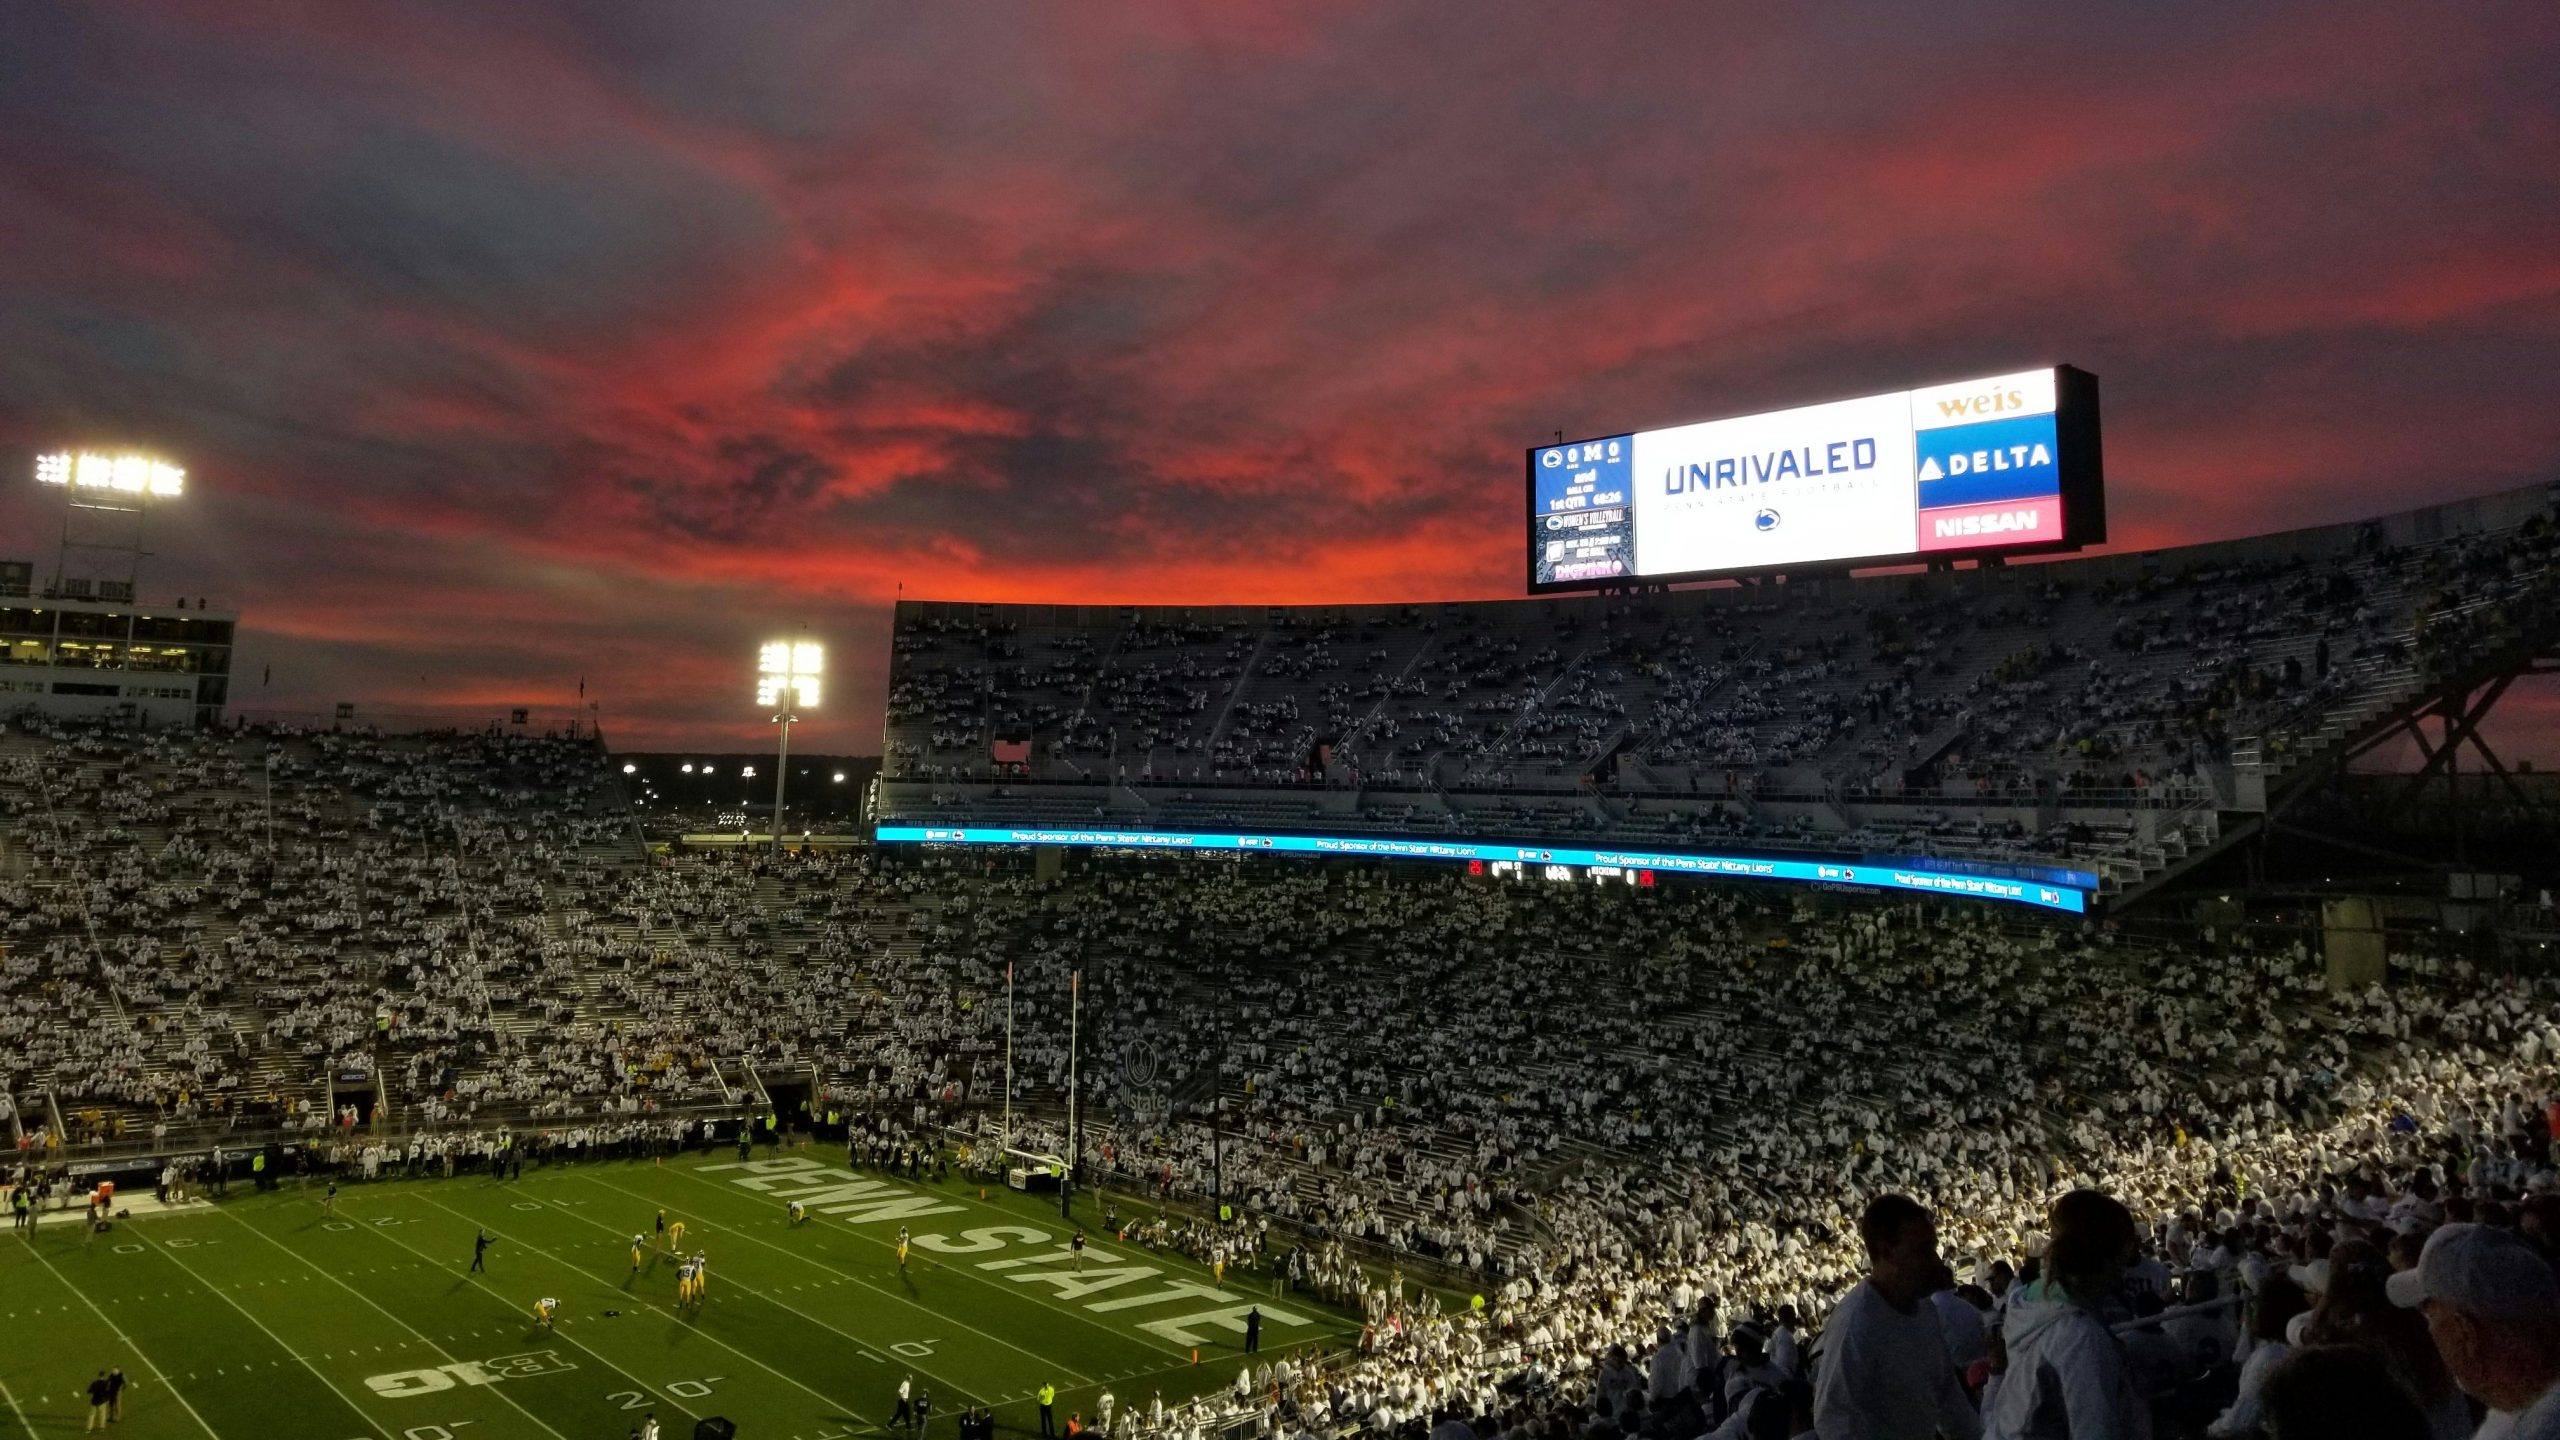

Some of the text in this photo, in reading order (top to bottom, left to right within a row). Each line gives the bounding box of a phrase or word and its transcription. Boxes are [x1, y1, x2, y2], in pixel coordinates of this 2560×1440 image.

[1937, 385, 2023, 418] weis
[1567, 442, 1619, 463] 0 M 0
[1950, 443, 2050, 476] DELTA
[1665, 437, 1876, 496] UNRIVALED
[1565, 496, 1586, 510] QTR
[1935, 510, 2037, 538] NISSAN
[1011, 831, 1035, 840] Proud
[1037, 832, 1068, 842] Sponsor
[1070, 833, 1080, 841] of
[1081, 833, 1094, 841] the
[1096, 833, 1115, 842] Penn
[1141, 834, 1169, 845] Nittany
[1316, 840, 1338, 849] Proud
[1340, 841, 1368, 851] Sponsor
[1370, 842, 1377, 850] of
[1378, 842, 1389, 851] the
[1391, 843, 1408, 852] Penn
[1429, 845, 1455, 856] Nittany
[1595, 853, 1618, 863] Proud
[1619, 855, 1650, 867] Sponsor
[1652, 856, 1661, 865] of
[1662, 857, 1674, 866] the
[1676, 858, 1695, 868] Penn
[1721, 860, 1751, 874] Nittany
[694, 1157, 1315, 1347] PENN STATE
